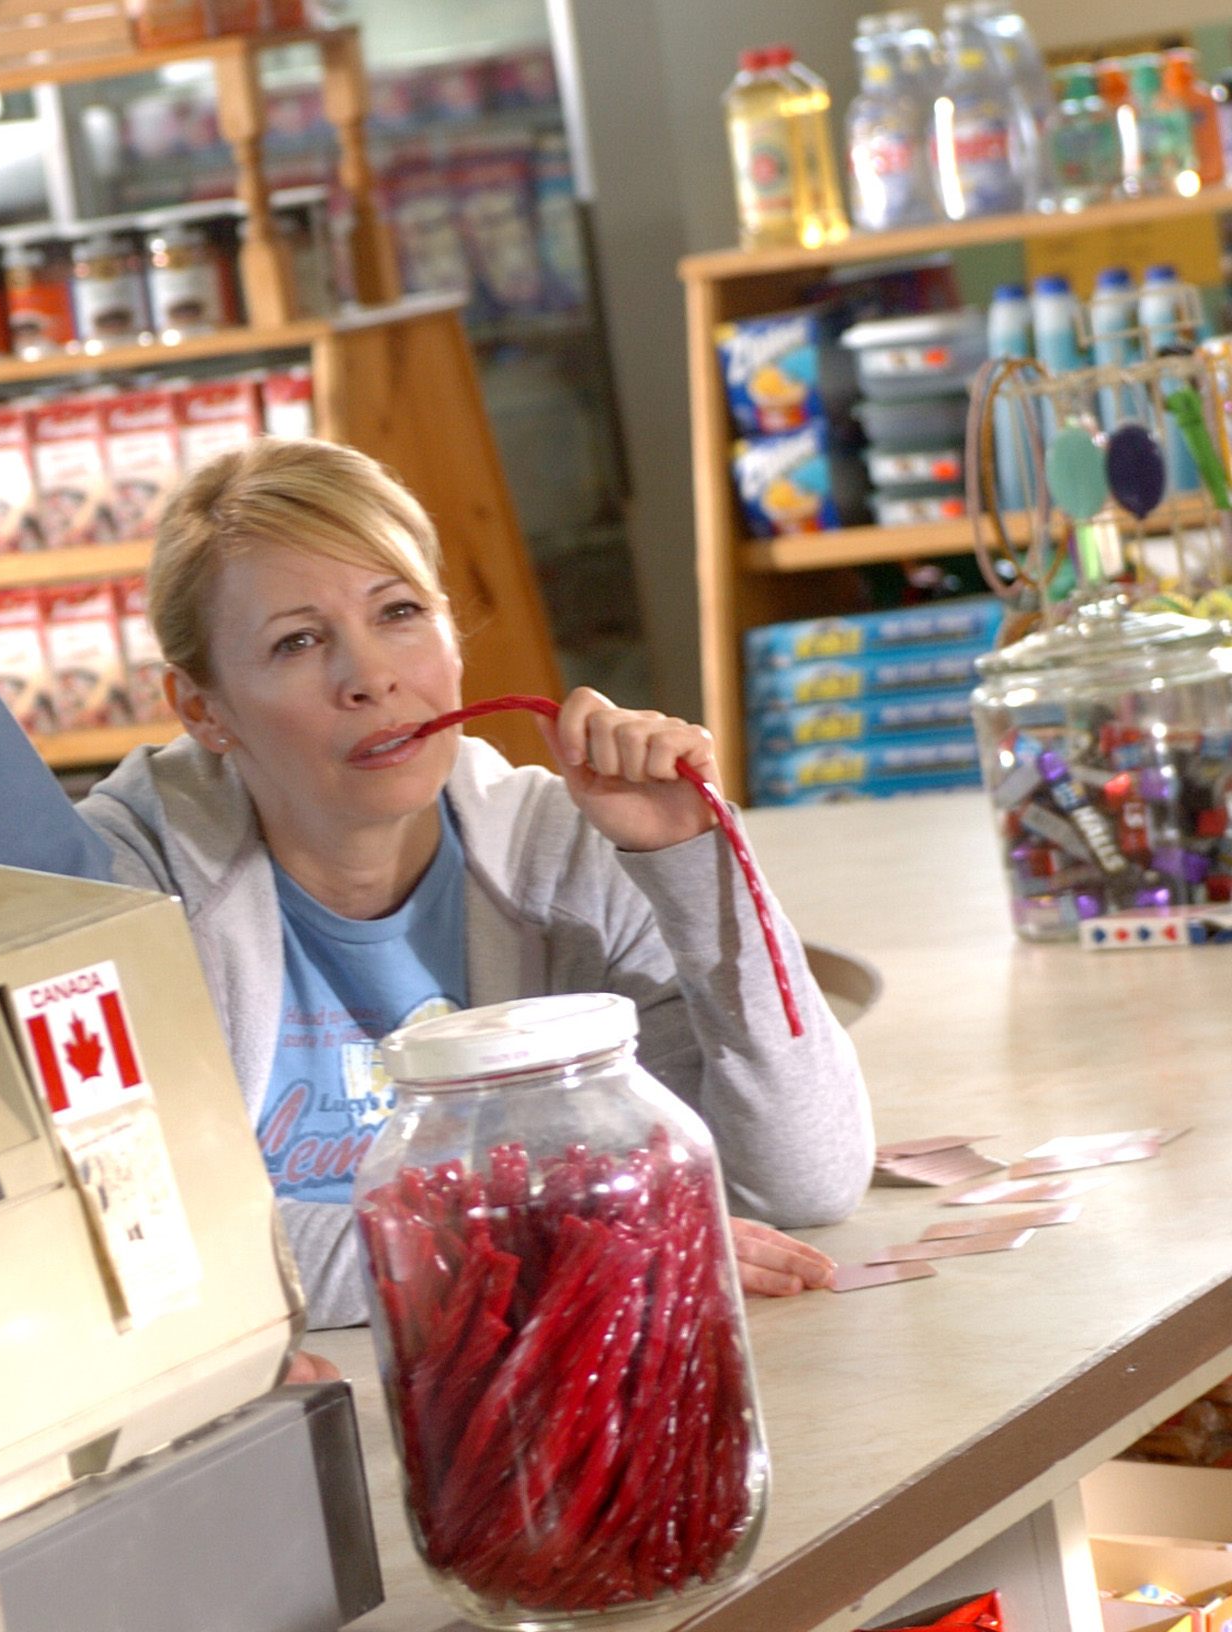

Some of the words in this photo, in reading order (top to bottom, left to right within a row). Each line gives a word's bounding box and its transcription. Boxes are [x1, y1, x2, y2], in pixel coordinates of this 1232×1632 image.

[1072, 805, 1129, 874] HALLS
[30, 972, 104, 1009] CANADA
[319, 1091, 379, 1116] Lucy's
